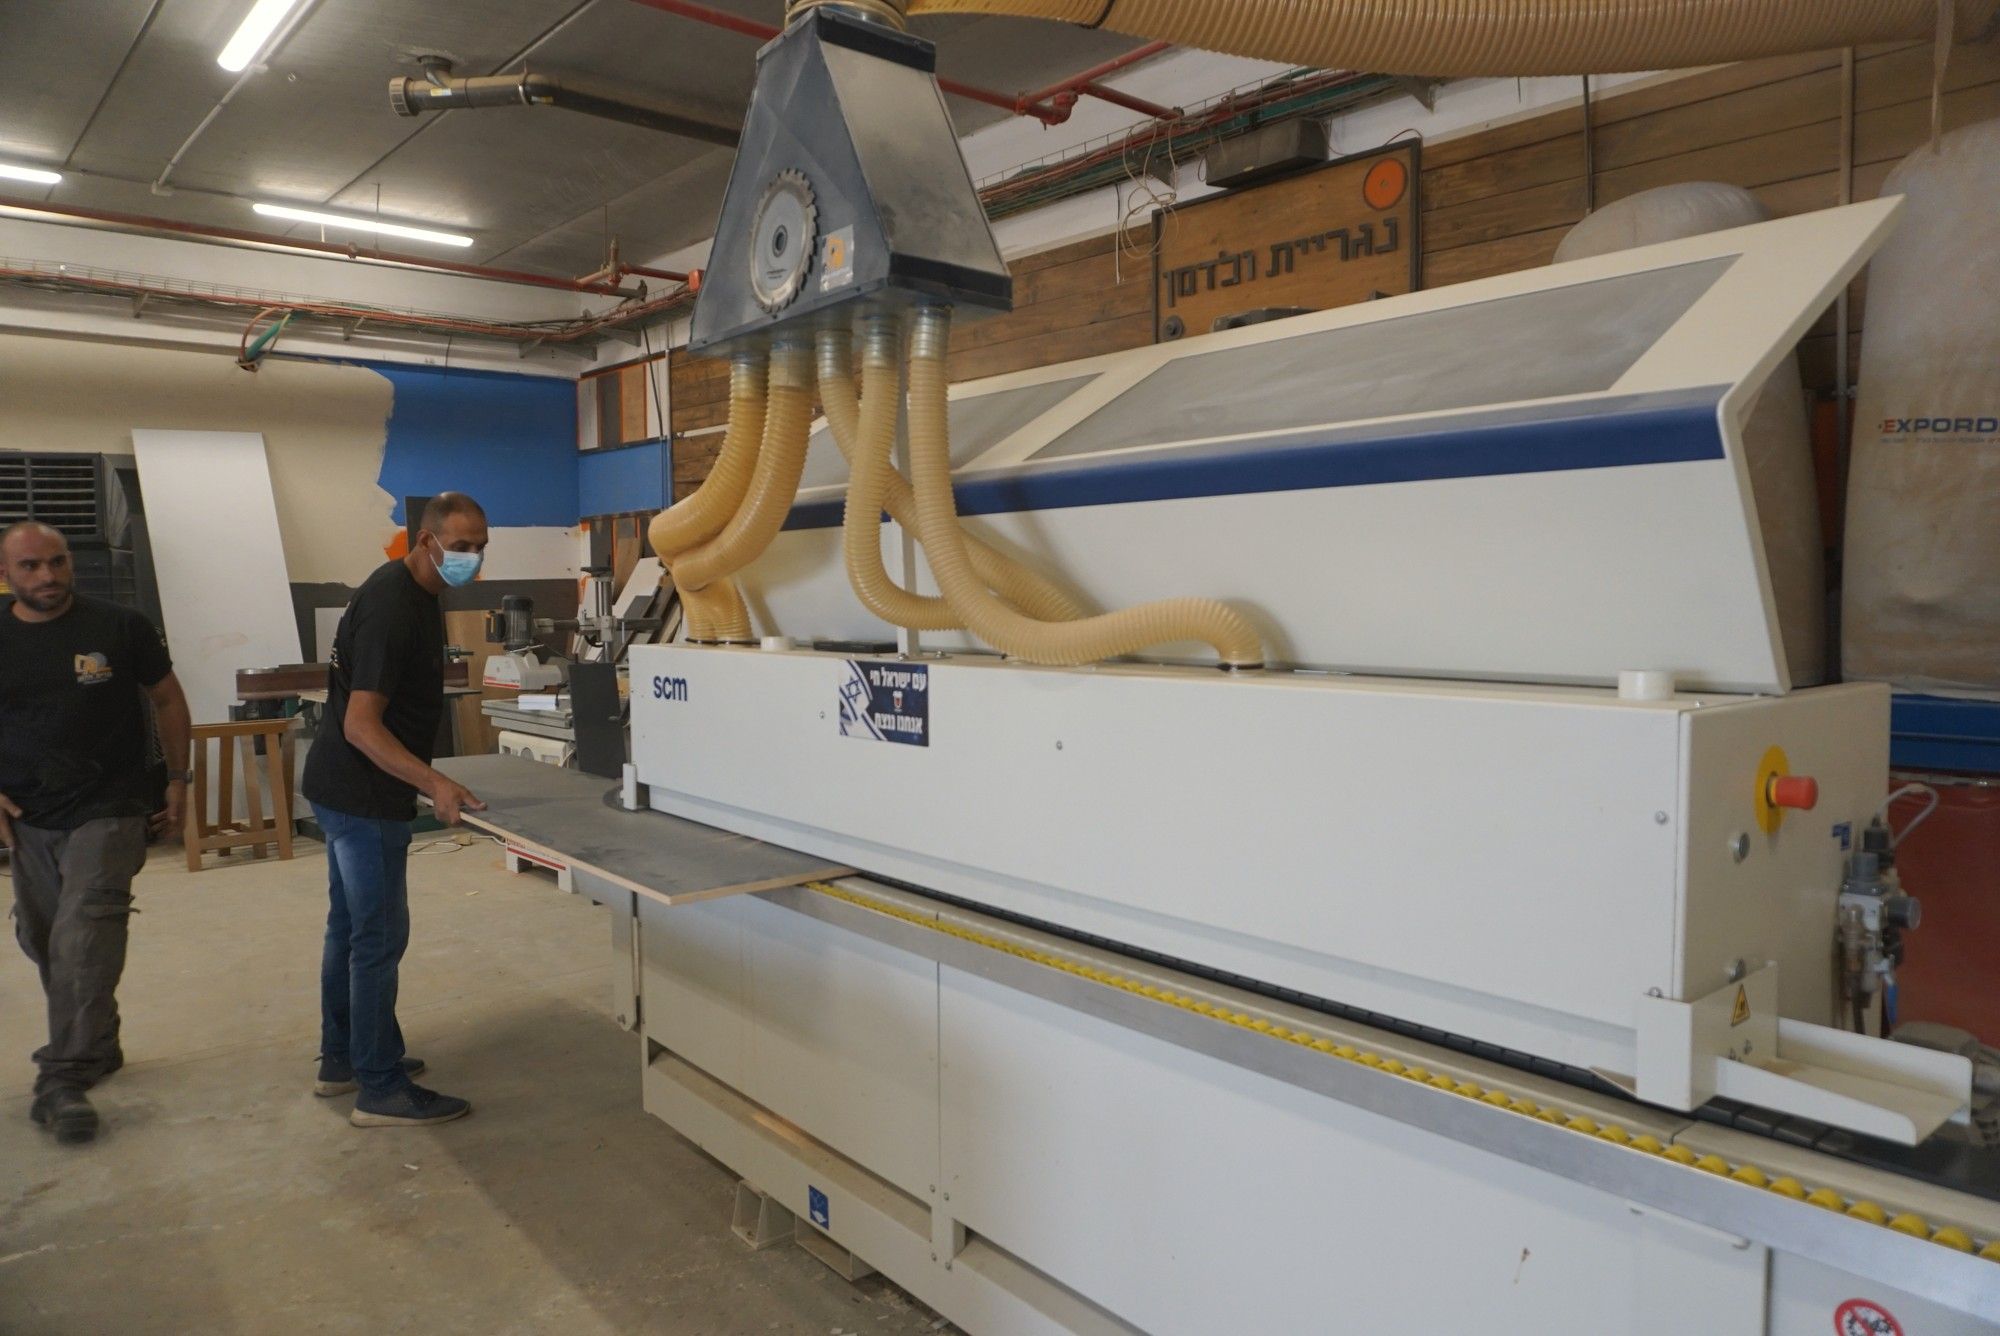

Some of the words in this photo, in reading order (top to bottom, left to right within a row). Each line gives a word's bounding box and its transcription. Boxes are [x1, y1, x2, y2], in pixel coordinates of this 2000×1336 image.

[1266, 217, 1399, 278] נגריית
[653, 675, 688, 702] scm
[869, 669, 881, 686] חי
[881, 666, 911, 689] ישראל
[912, 672, 927, 692] עם
